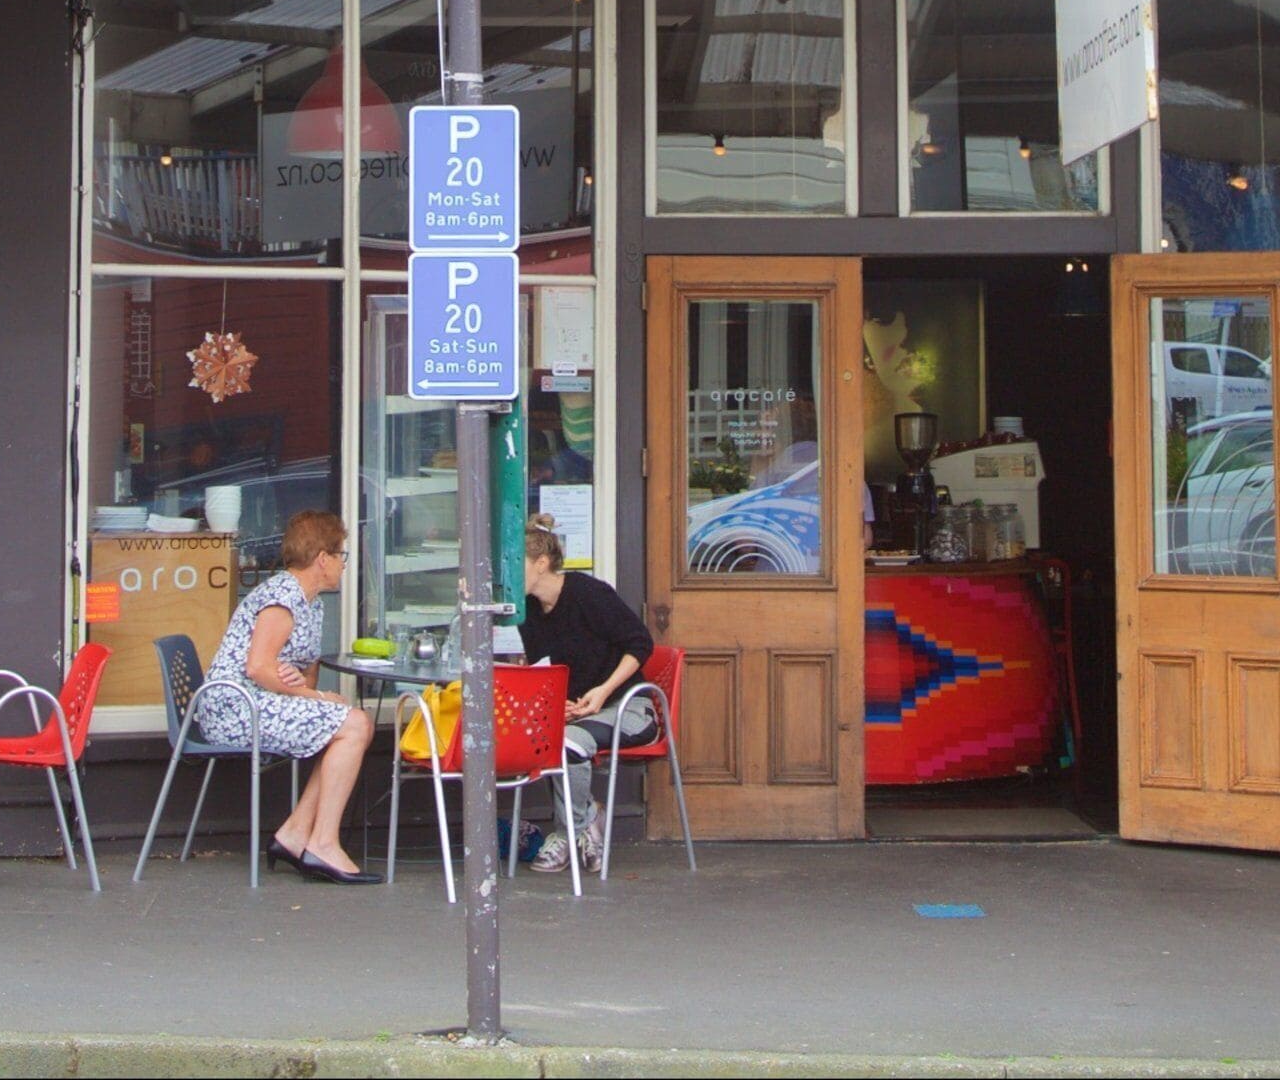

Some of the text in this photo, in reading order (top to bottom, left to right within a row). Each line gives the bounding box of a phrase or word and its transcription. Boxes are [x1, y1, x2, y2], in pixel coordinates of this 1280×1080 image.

[1063, 4, 1141, 88] www.arocoffee.co.nz
[450, 115, 480, 153] P
[446, 157, 483, 187] 20
[428, 192, 501, 206] Mon-Sat
[425, 211, 504, 228] 8am-6pm
[448, 261, 479, 300] P
[444, 303, 482, 334] 20
[429, 339, 498, 354] Sat-Sun
[424, 359, 503, 375] 8am-6pm
[710, 388, 797, 402] arocafé
